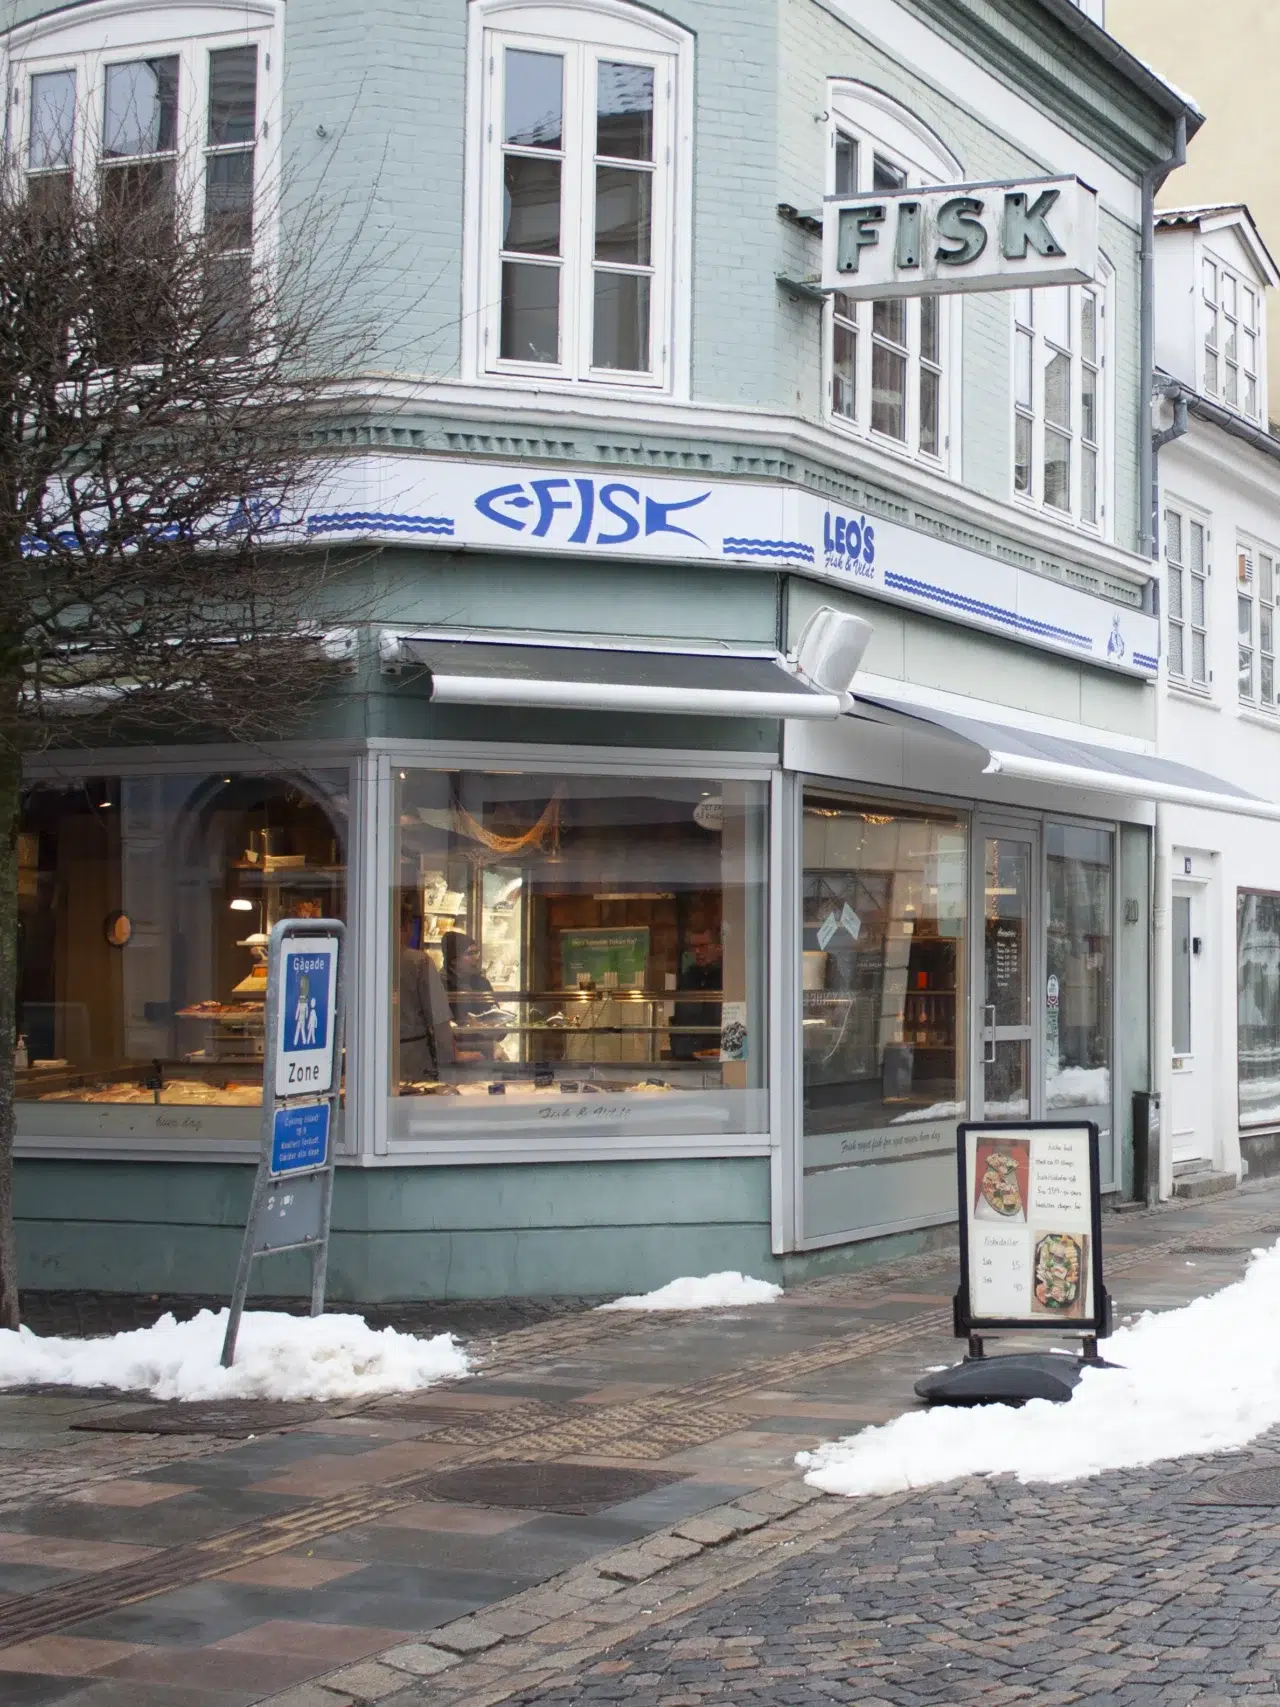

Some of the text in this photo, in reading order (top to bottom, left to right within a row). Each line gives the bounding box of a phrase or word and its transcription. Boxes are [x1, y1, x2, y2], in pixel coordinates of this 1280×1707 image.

[837, 189, 1067, 273] FISK
[823, 511, 875, 564] LEO'S
[293, 957, 325, 972] Gågade
[288, 1062, 320, 1083] Zone
